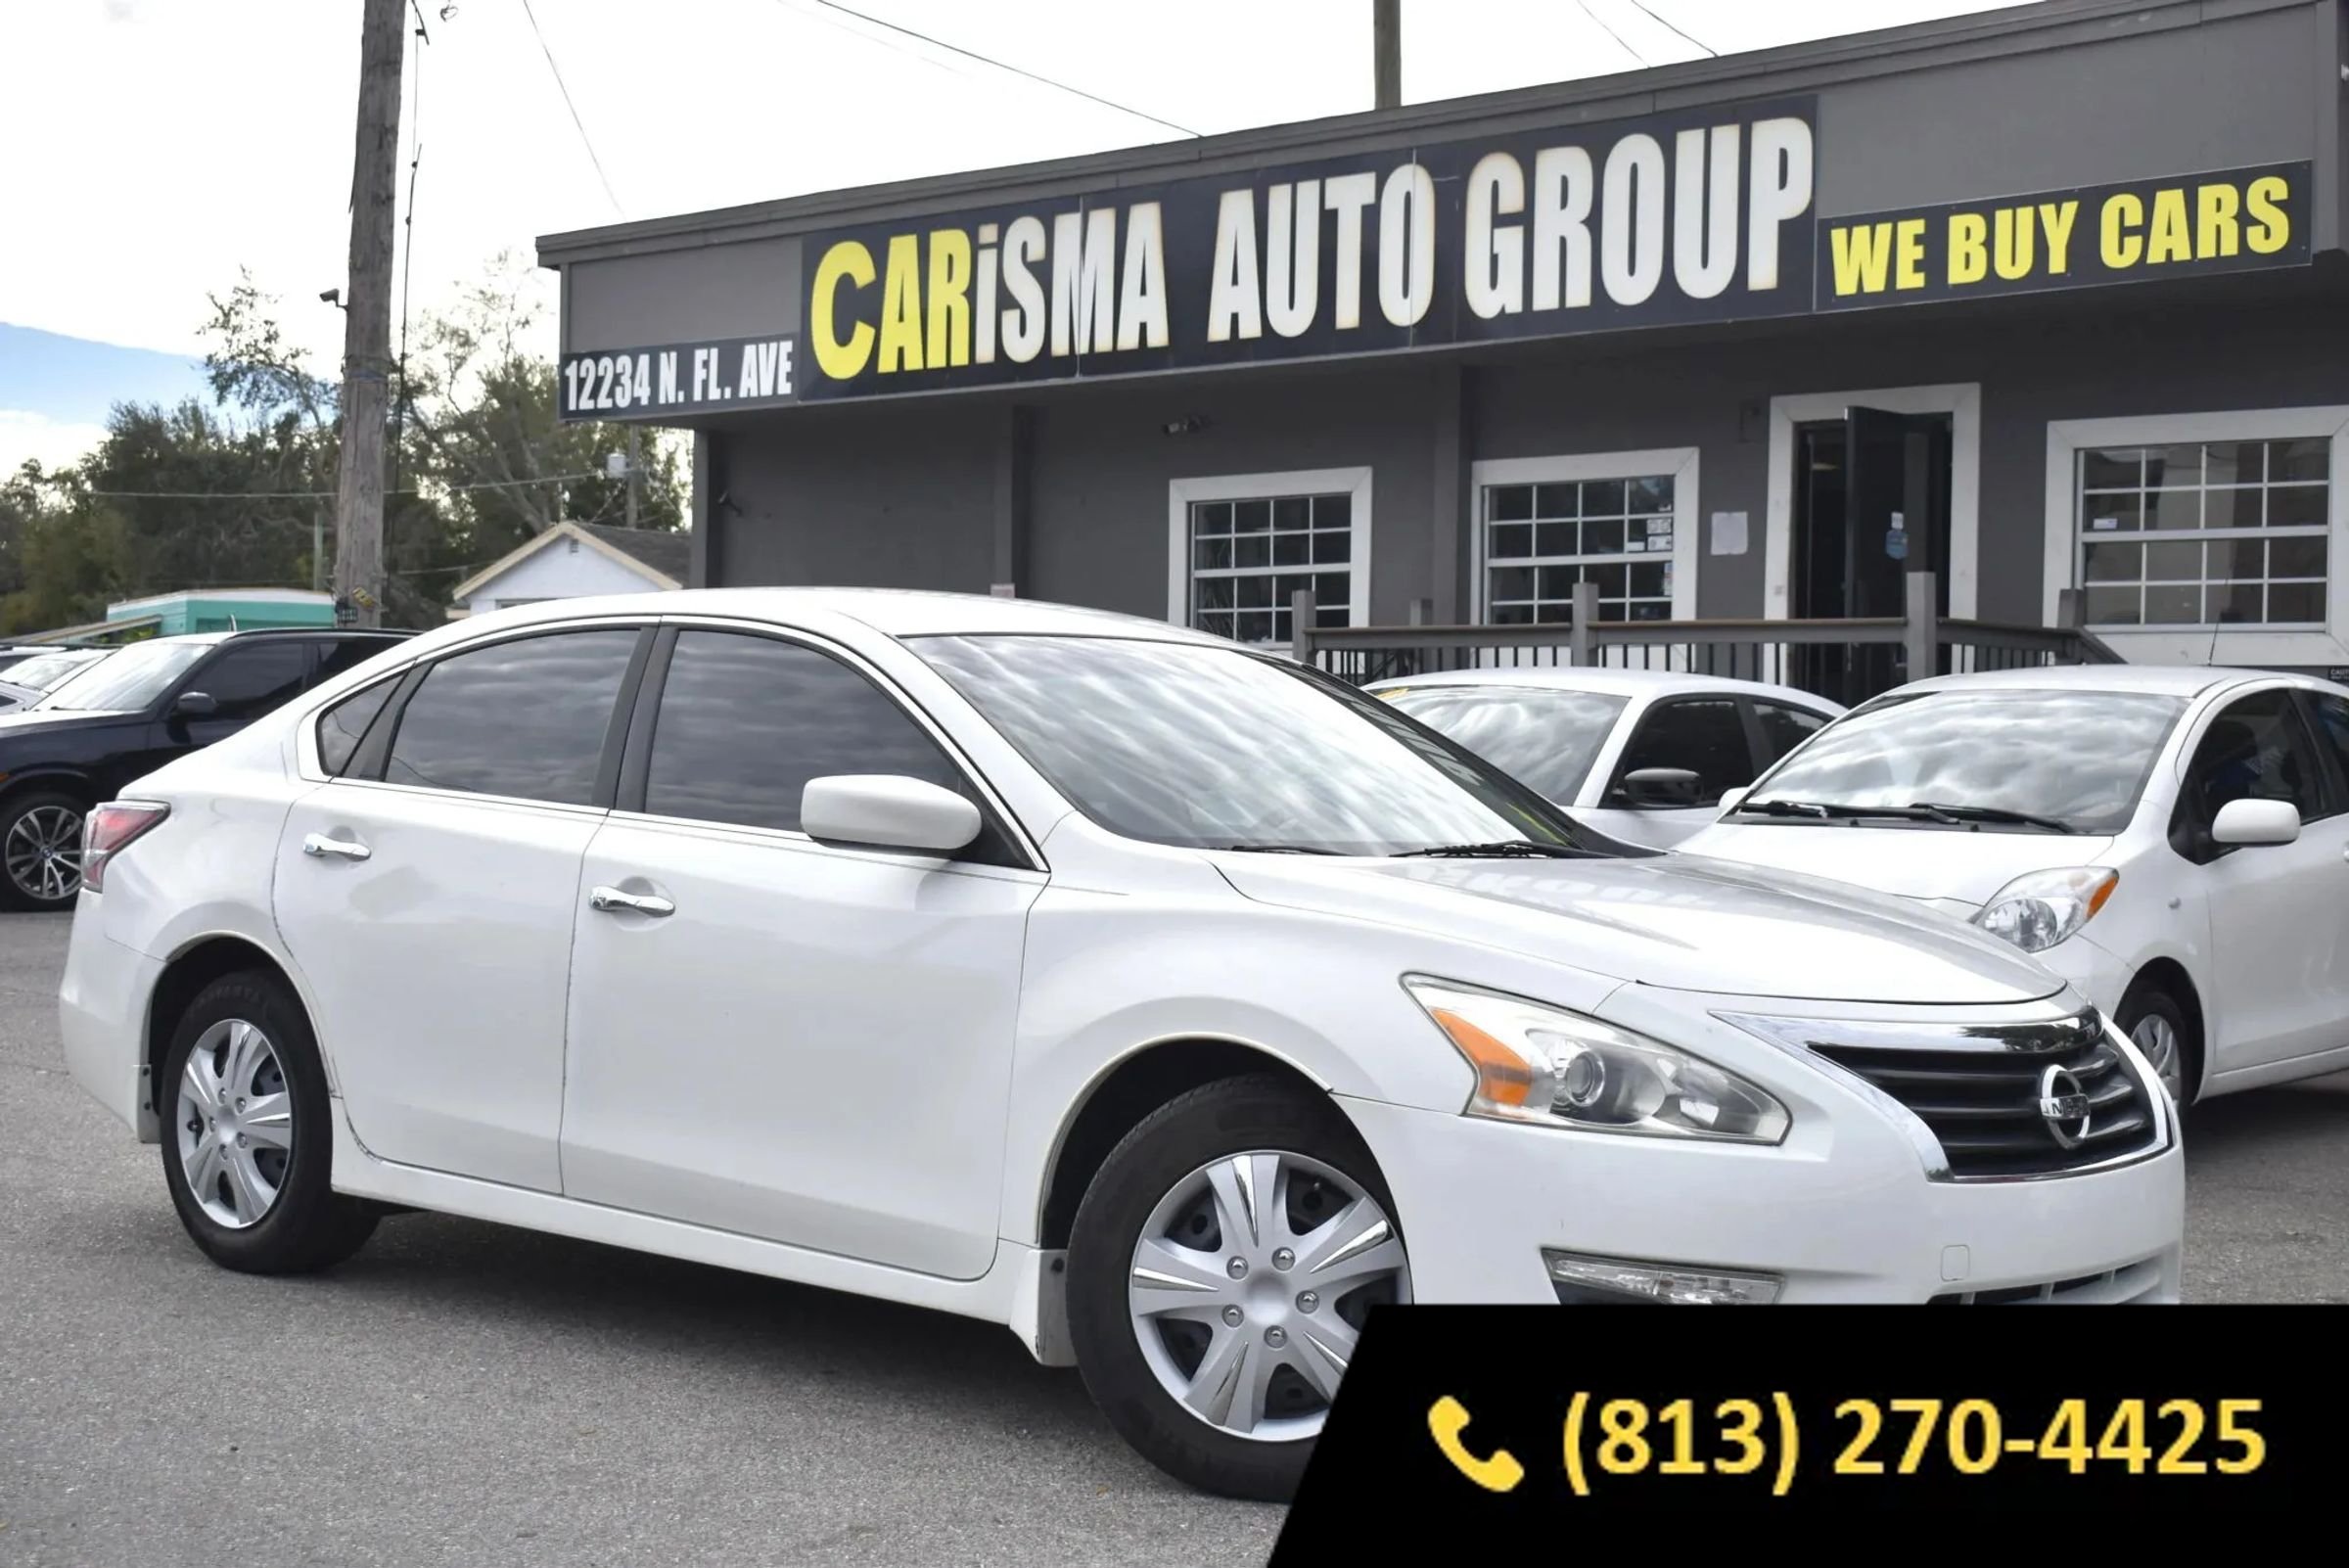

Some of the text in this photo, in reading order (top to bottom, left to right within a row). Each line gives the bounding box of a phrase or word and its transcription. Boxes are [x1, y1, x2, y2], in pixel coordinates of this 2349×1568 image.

[1207, 163, 1436, 342] AUTO
[1465, 117, 1814, 319] GROUP
[1830, 176, 2289, 296] WE BUY CARS
[565, 341, 794, 411] 12234 N. FL. AVE
